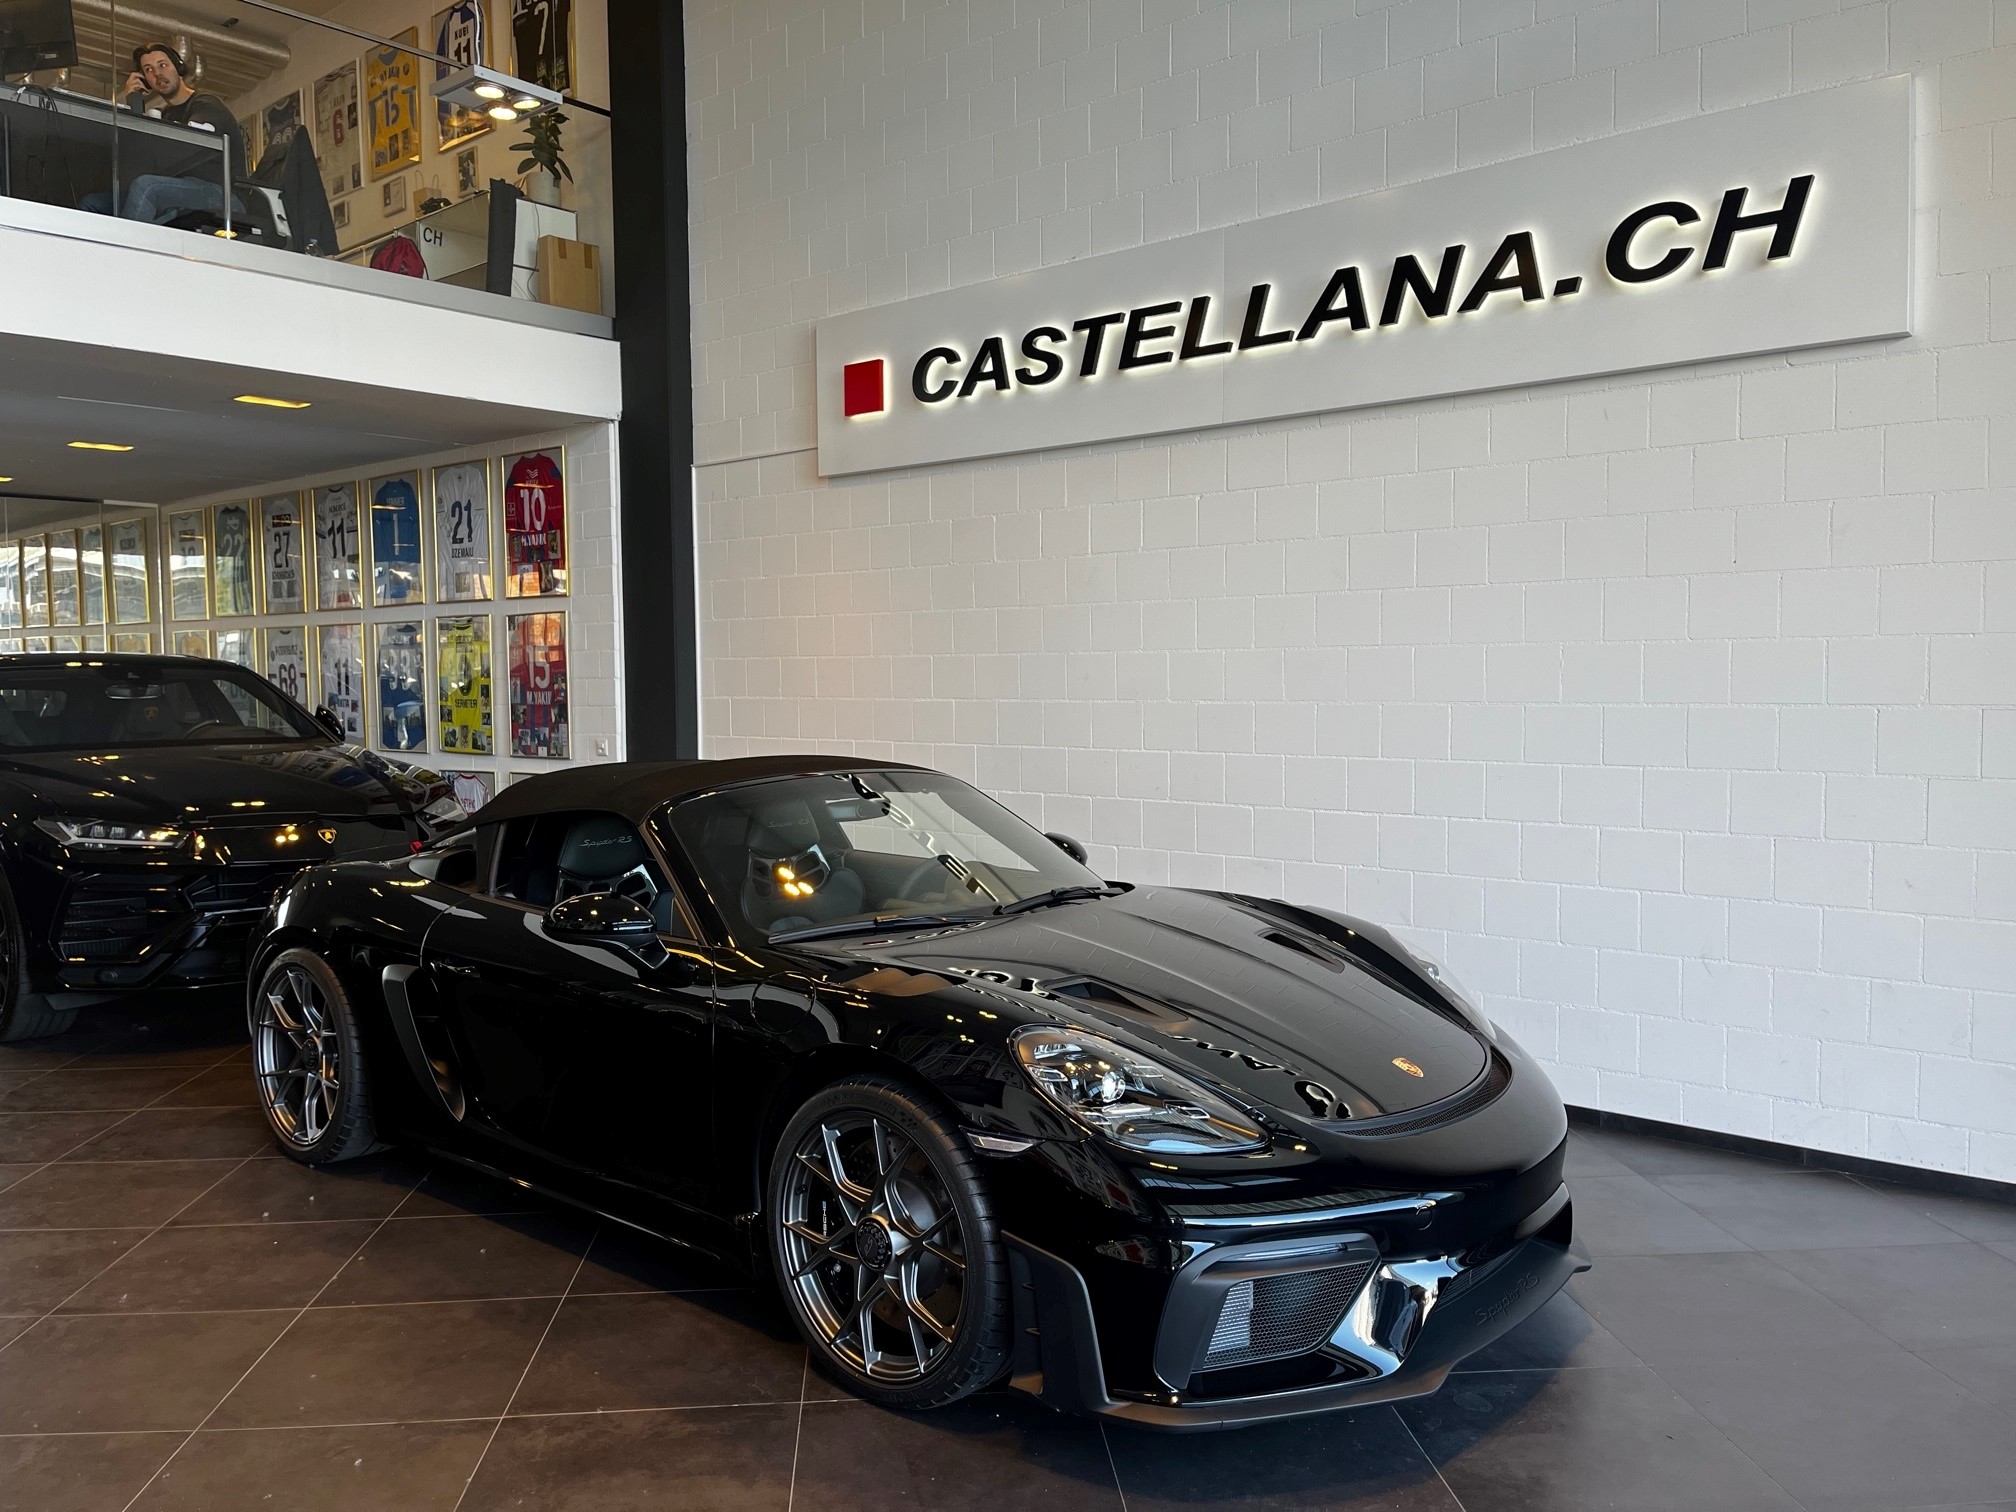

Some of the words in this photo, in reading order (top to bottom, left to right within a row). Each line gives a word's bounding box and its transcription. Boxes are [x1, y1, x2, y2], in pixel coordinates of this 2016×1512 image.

[534, 1, 549, 55] 7
[423, 227, 443, 247] CH
[912, 174, 1815, 403] CASTELLANA.CH
[451, 499, 473, 545] 21
[520, 487, 547, 532] 10
[273, 530, 291, 569] 27
[327, 518, 346, 559] 11
[278, 663, 299, 700] 68
[334, 657, 350, 696] 11
[526, 644, 551, 689] 15
[617, 835, 633, 844] RS
[1475, 1287, 1519, 1326] Spyder
[1517, 1272, 1541, 1293] RS
